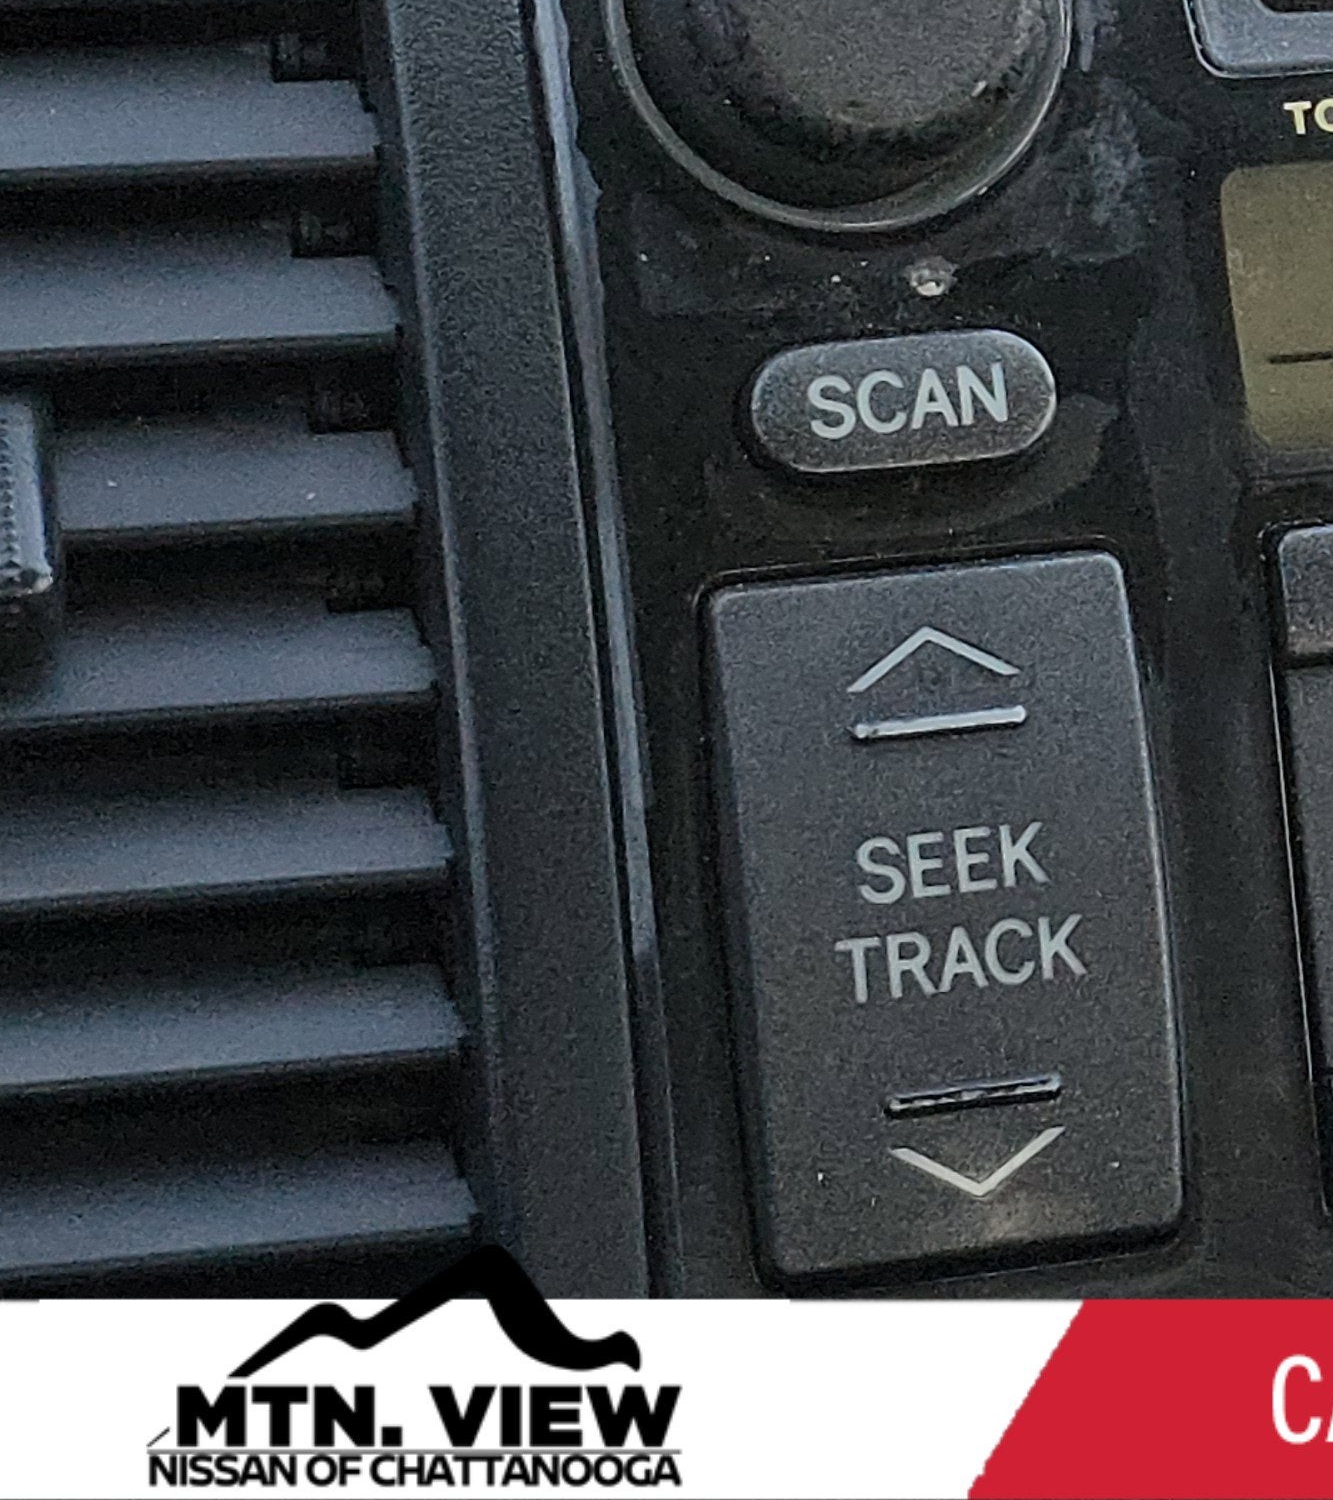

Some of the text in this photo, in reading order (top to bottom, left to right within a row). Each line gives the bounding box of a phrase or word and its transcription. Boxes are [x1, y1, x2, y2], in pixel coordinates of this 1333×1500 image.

[807, 363, 1010, 440] SCAN
[856, 821, 1049, 905] SEEK
[835, 914, 1087, 1003] TRACK
